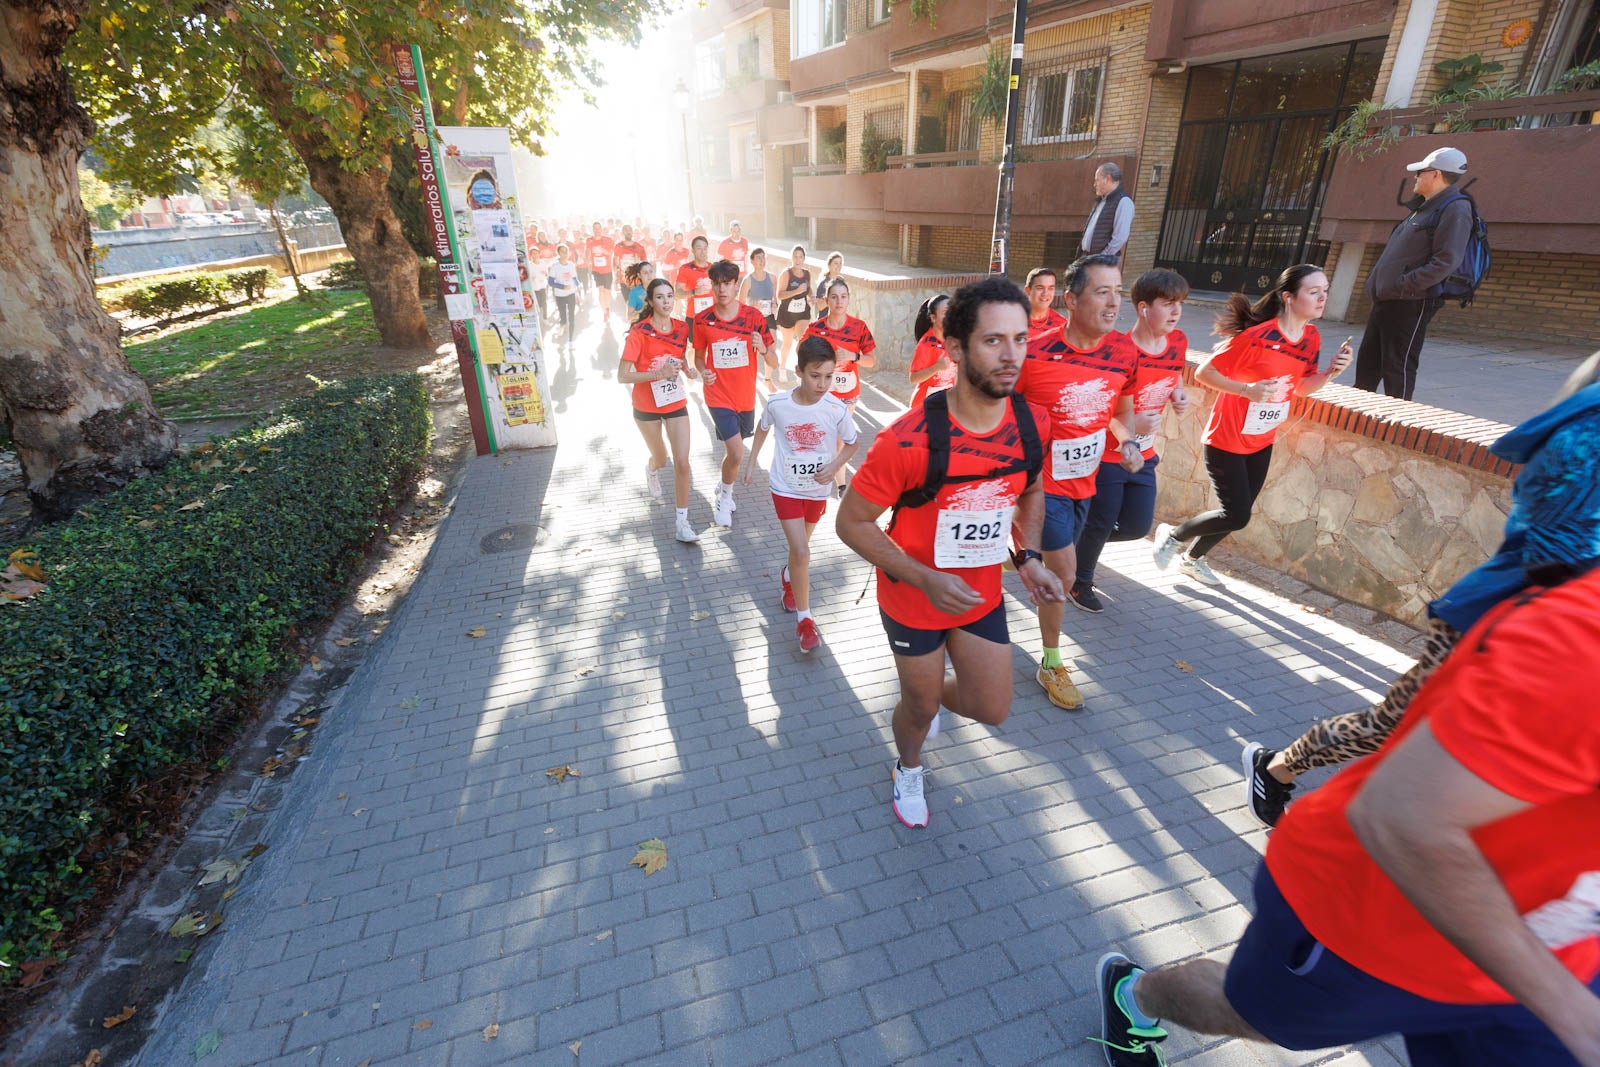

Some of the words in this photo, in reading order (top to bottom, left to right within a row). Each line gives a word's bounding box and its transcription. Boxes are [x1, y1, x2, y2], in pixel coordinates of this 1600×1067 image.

[1277, 95, 1286, 109] 2
[427, 185, 449, 255] tinerarios
[720, 347, 739, 357] 734
[660, 382, 677, 393] 726
[1258, 410, 1281, 420] 996
[1062, 442, 1099, 461] 1327
[951, 521, 1002, 541] 1292
